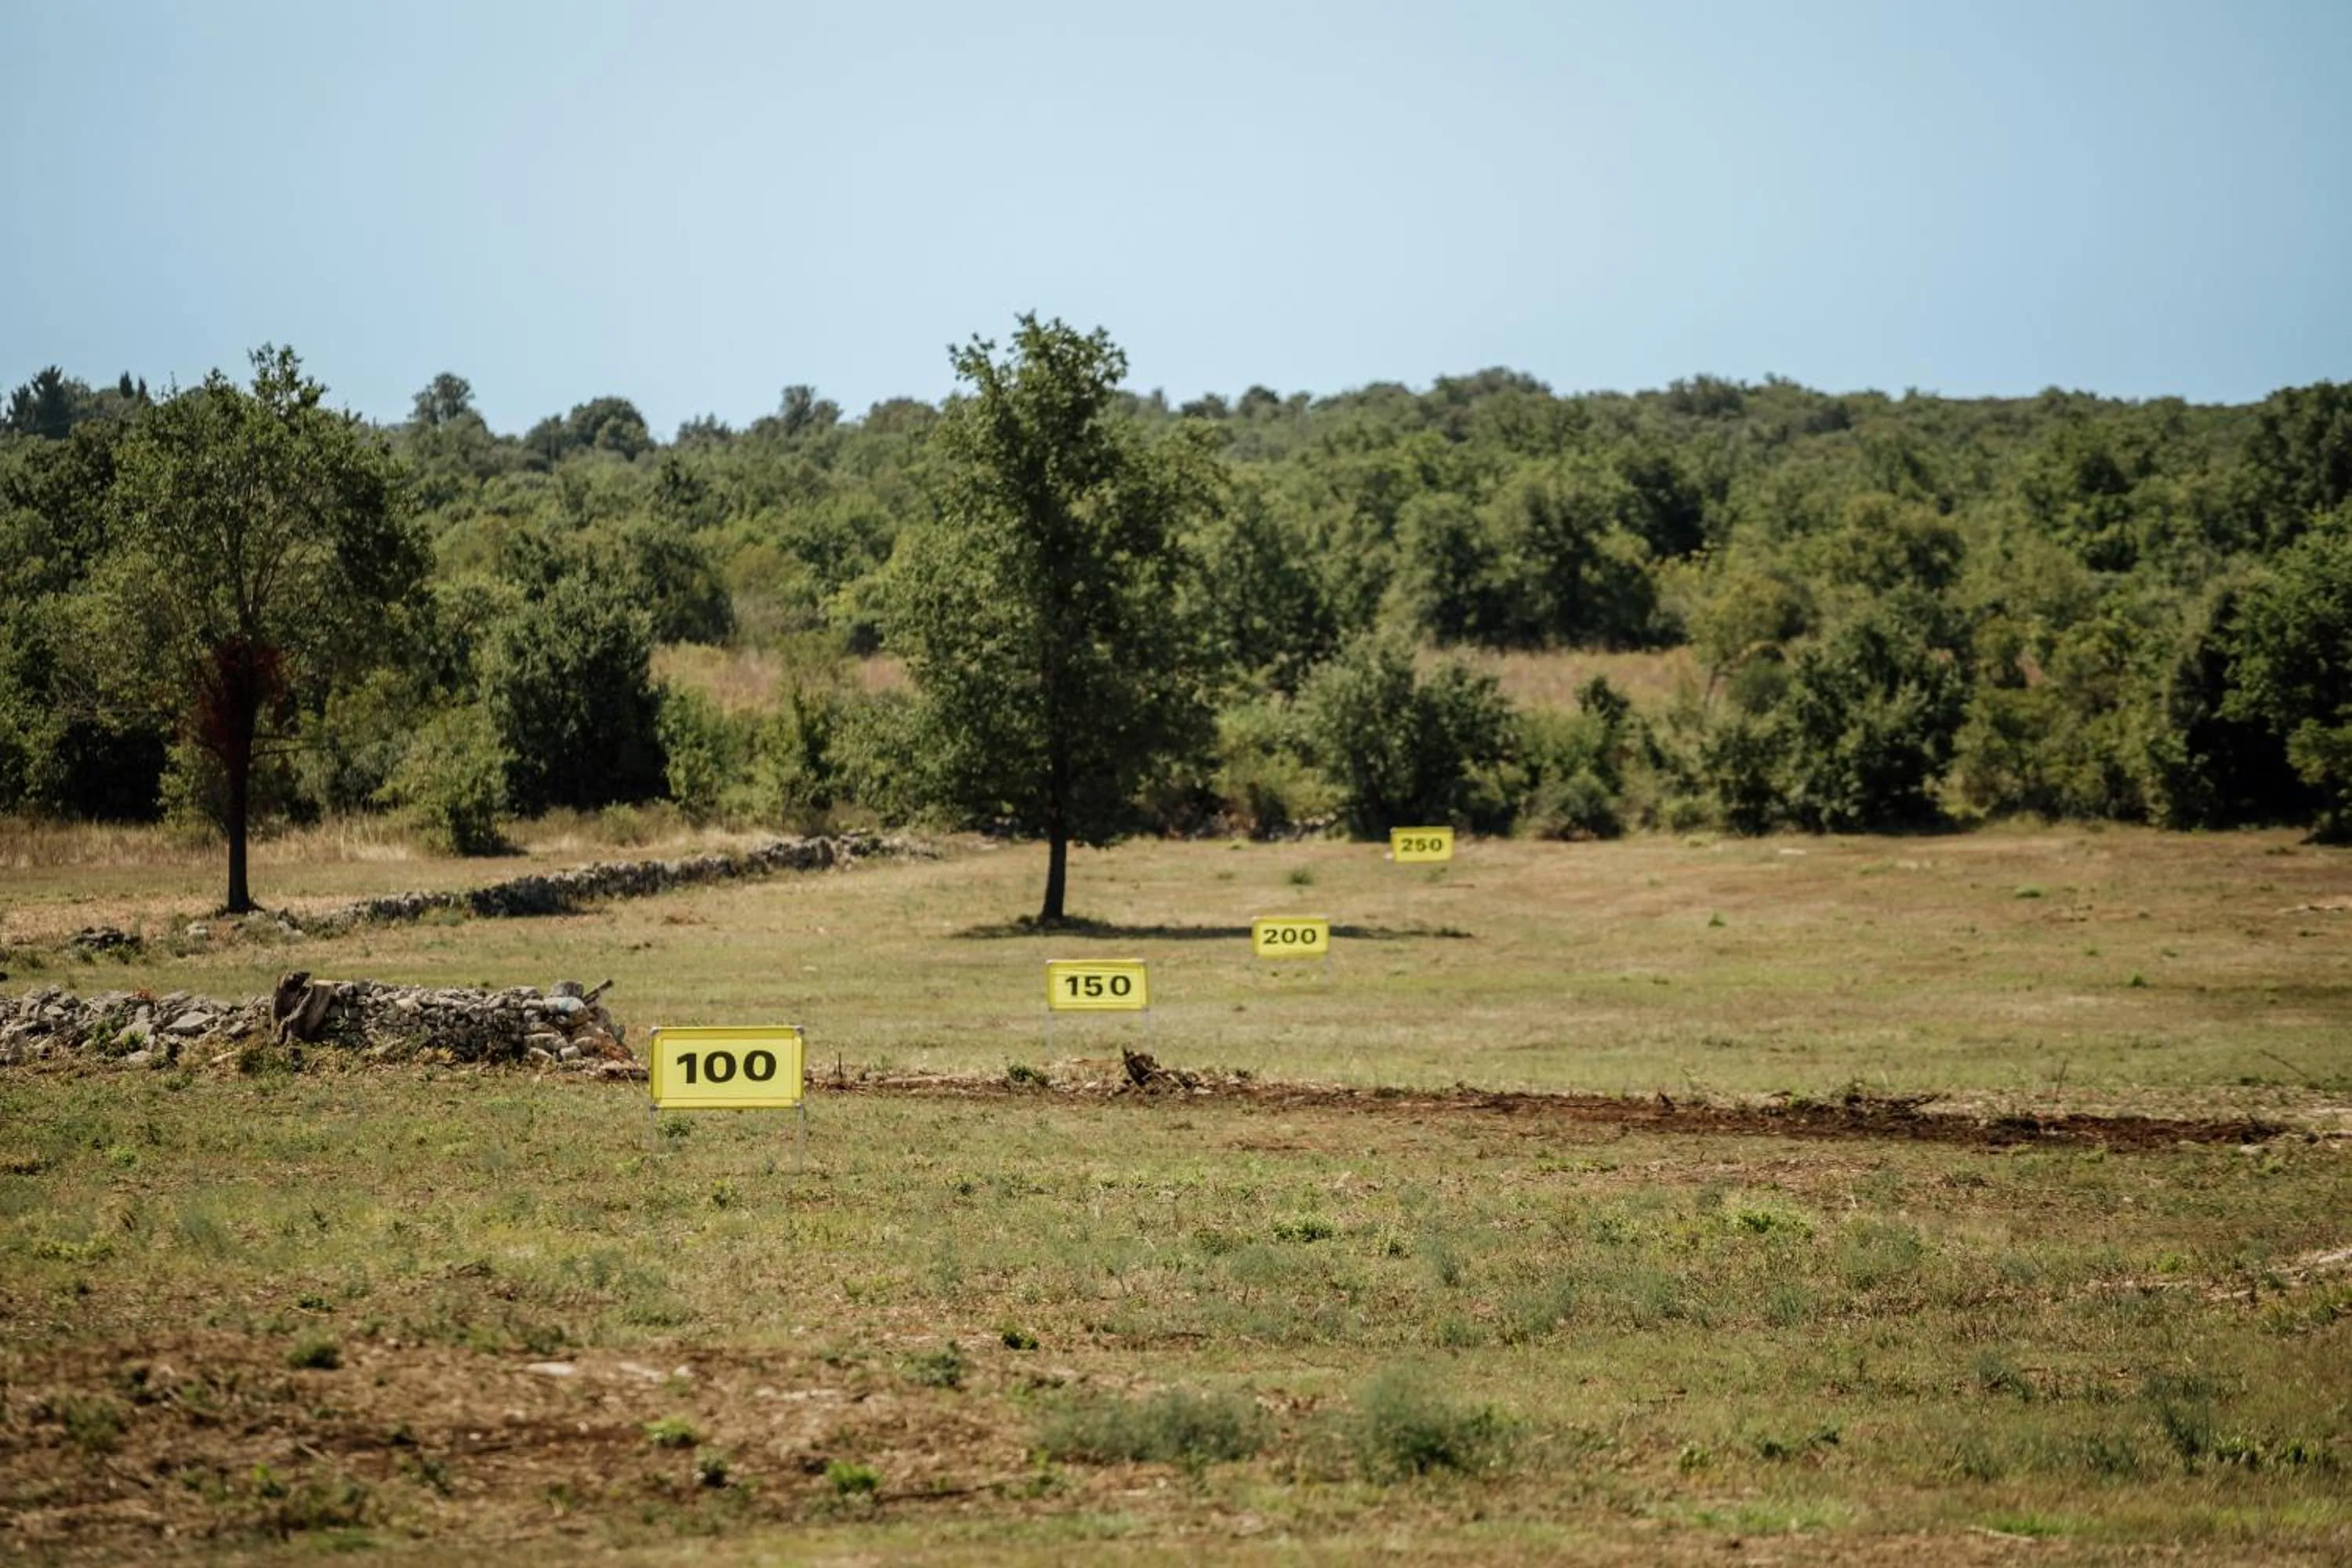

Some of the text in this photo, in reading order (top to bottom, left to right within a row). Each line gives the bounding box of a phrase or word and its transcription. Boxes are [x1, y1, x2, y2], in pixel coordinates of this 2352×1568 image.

[1401, 837, 1443, 853] 250
[1263, 927, 1317, 945] 200
[1065, 975, 1131, 996] 150
[677, 1050, 777, 1084] 100
